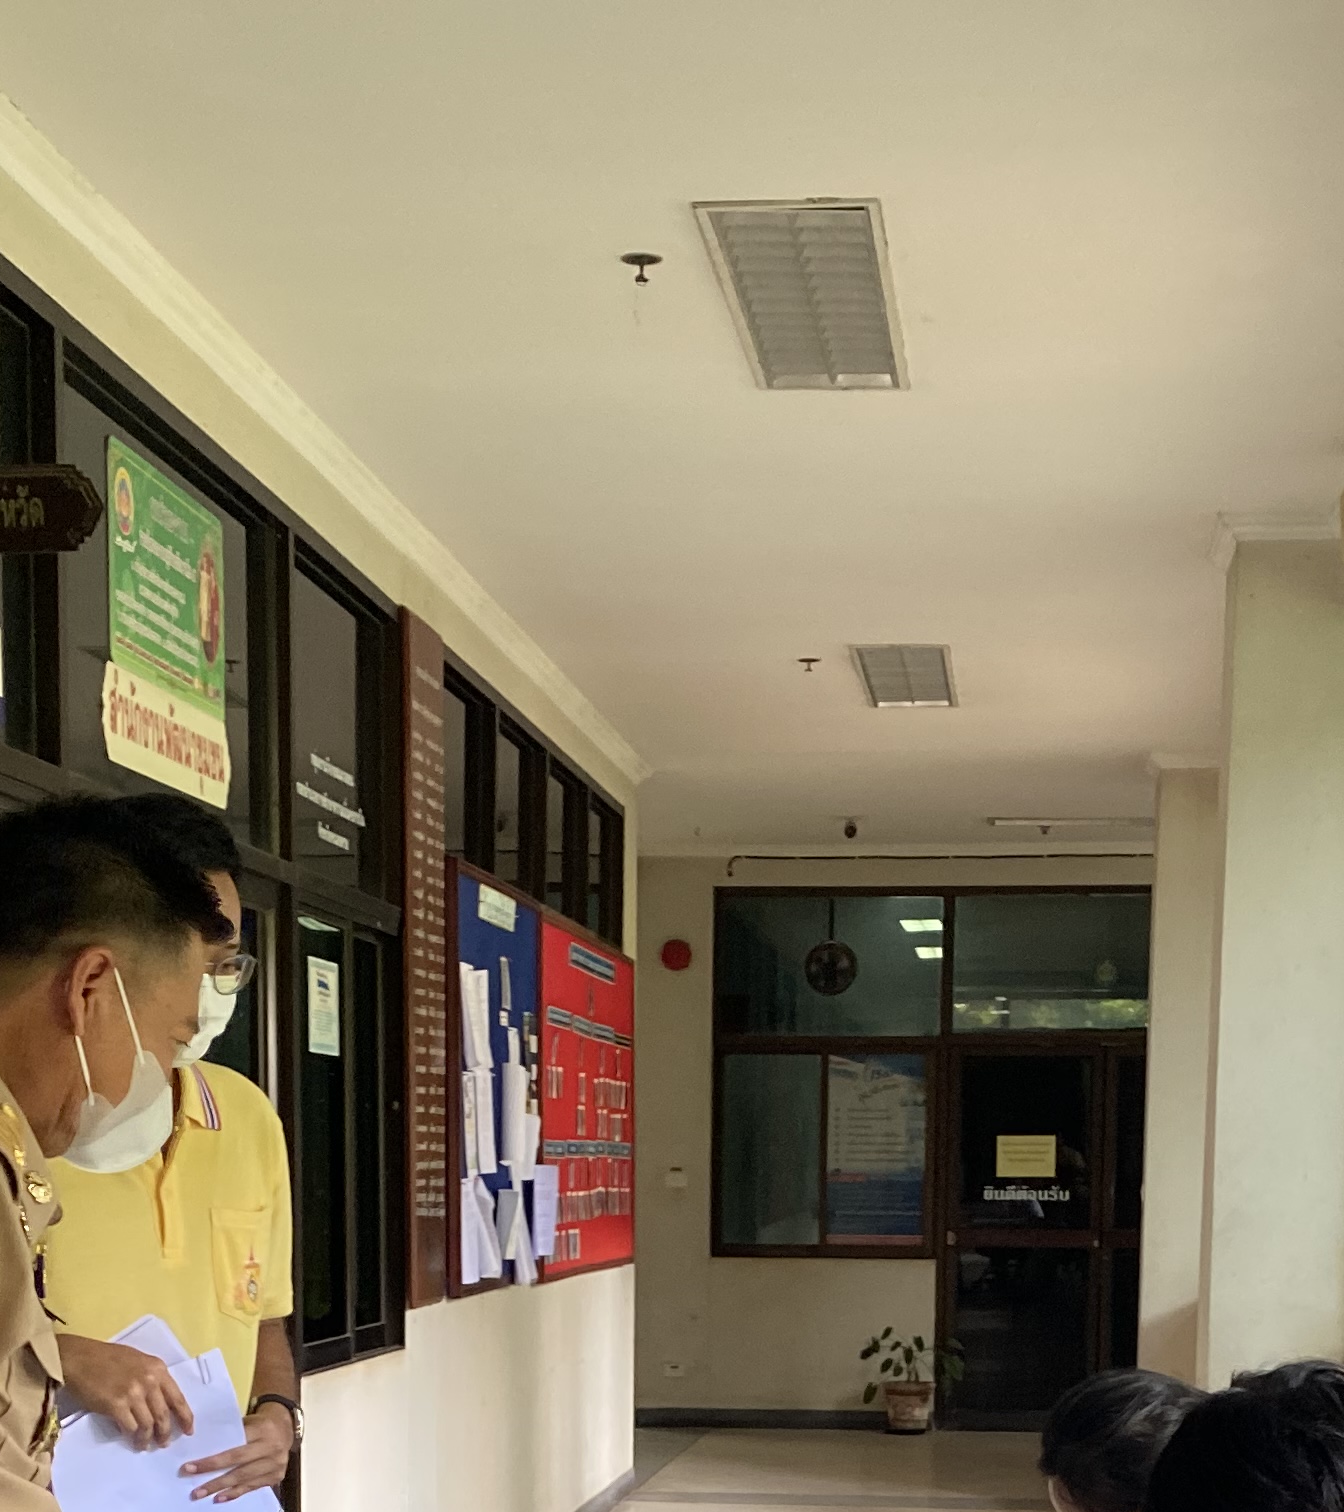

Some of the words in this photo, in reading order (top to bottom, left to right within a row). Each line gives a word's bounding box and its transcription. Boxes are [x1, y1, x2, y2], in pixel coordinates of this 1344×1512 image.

[109, 668, 225, 796] สำนักงานพัฒนาชุมชน
